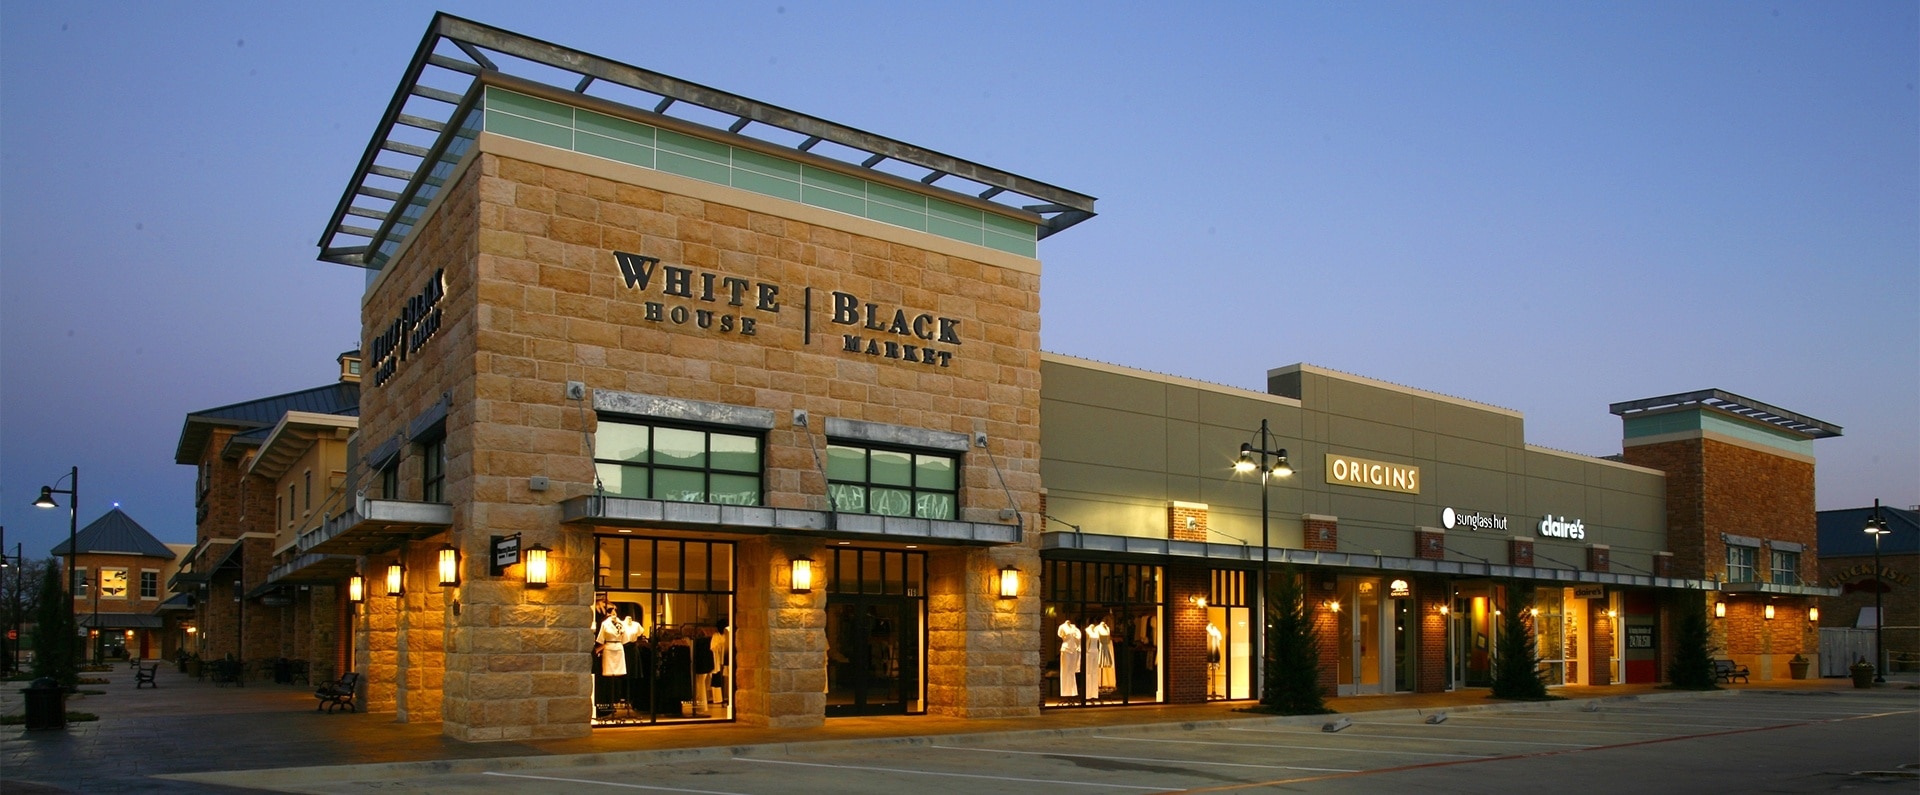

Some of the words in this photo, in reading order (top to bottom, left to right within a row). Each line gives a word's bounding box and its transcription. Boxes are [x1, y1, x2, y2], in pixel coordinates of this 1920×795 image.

[614, 251, 779, 312] WHITE
[832, 291, 962, 345] BLACK
[644, 301, 757, 336] HOUSE
[843, 335, 952, 368] MARKET
[1333, 459, 1416, 490] ORIGINS
[1456, 511, 1493, 531] sunglass
[1493, 514, 1508, 530] hut
[1540, 514, 1585, 539] claire's
